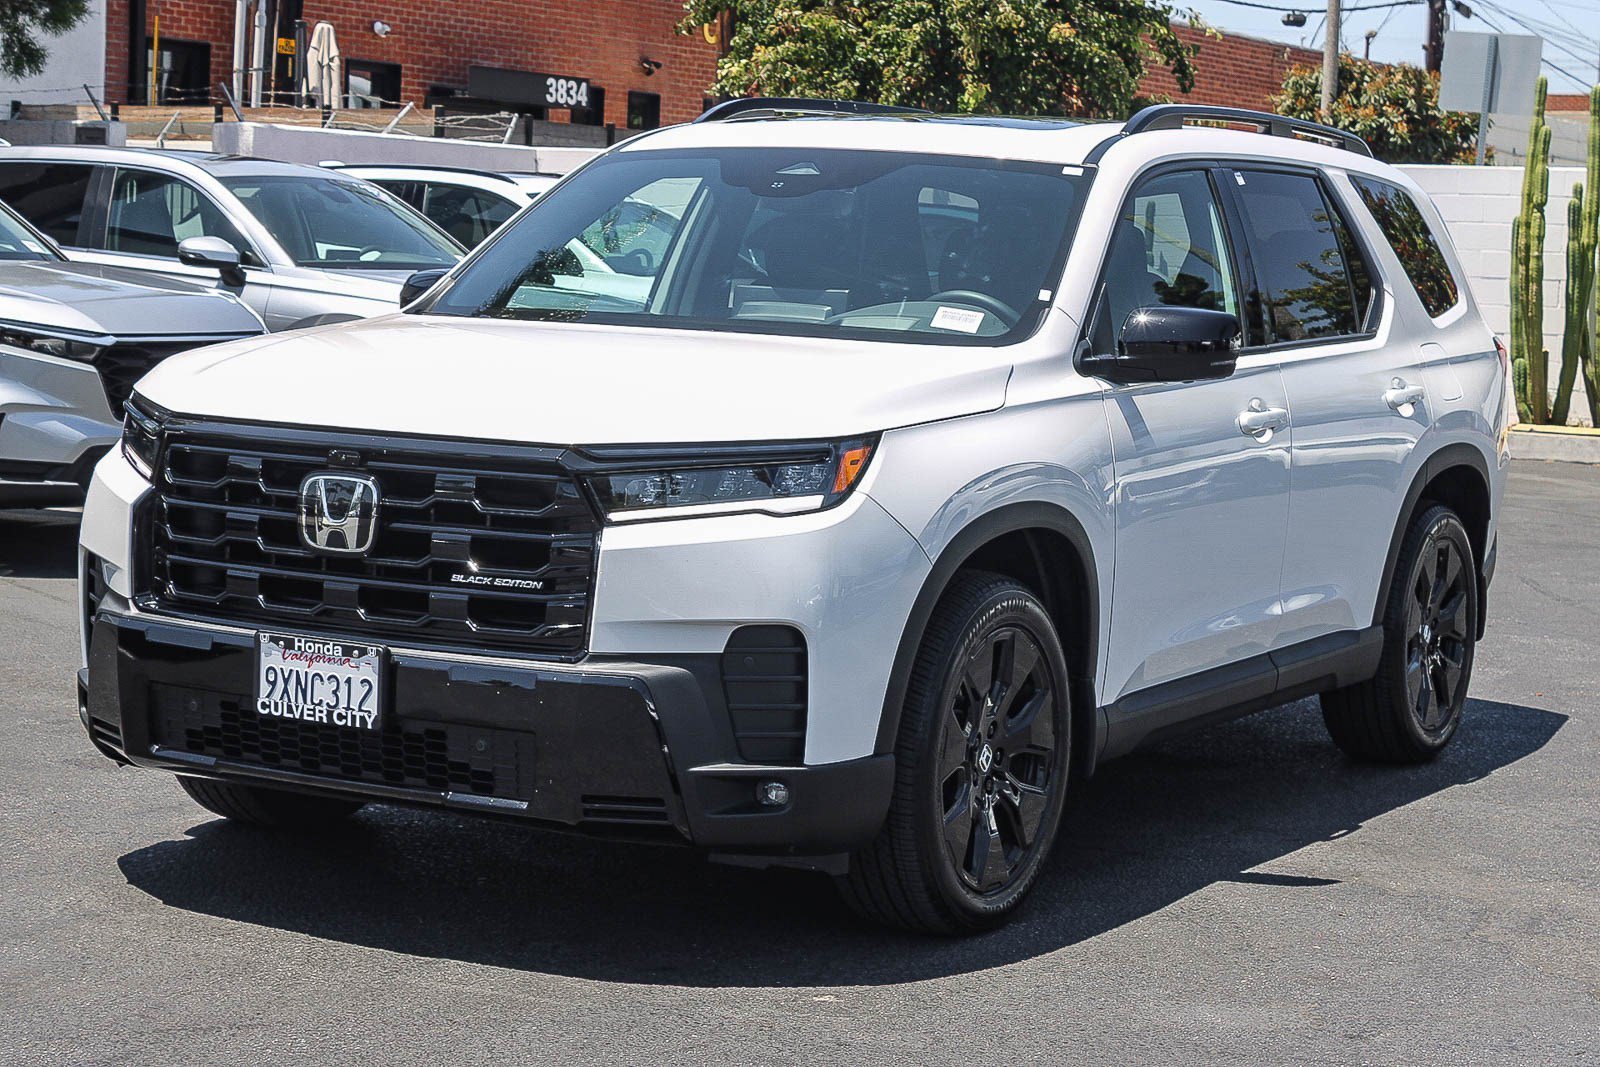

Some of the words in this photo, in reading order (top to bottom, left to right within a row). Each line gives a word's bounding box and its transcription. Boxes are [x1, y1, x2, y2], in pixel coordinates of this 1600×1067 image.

[545, 77, 588, 107] 3834
[450, 573, 493, 585] BLACK
[494, 578, 543, 590] EDITION
[281, 647, 360, 669] California
[294, 637, 343, 657] Honda
[265, 665, 373, 713] 9XNC312
[256, 698, 327, 724] CULVER
[332, 709, 377, 730] CITY
